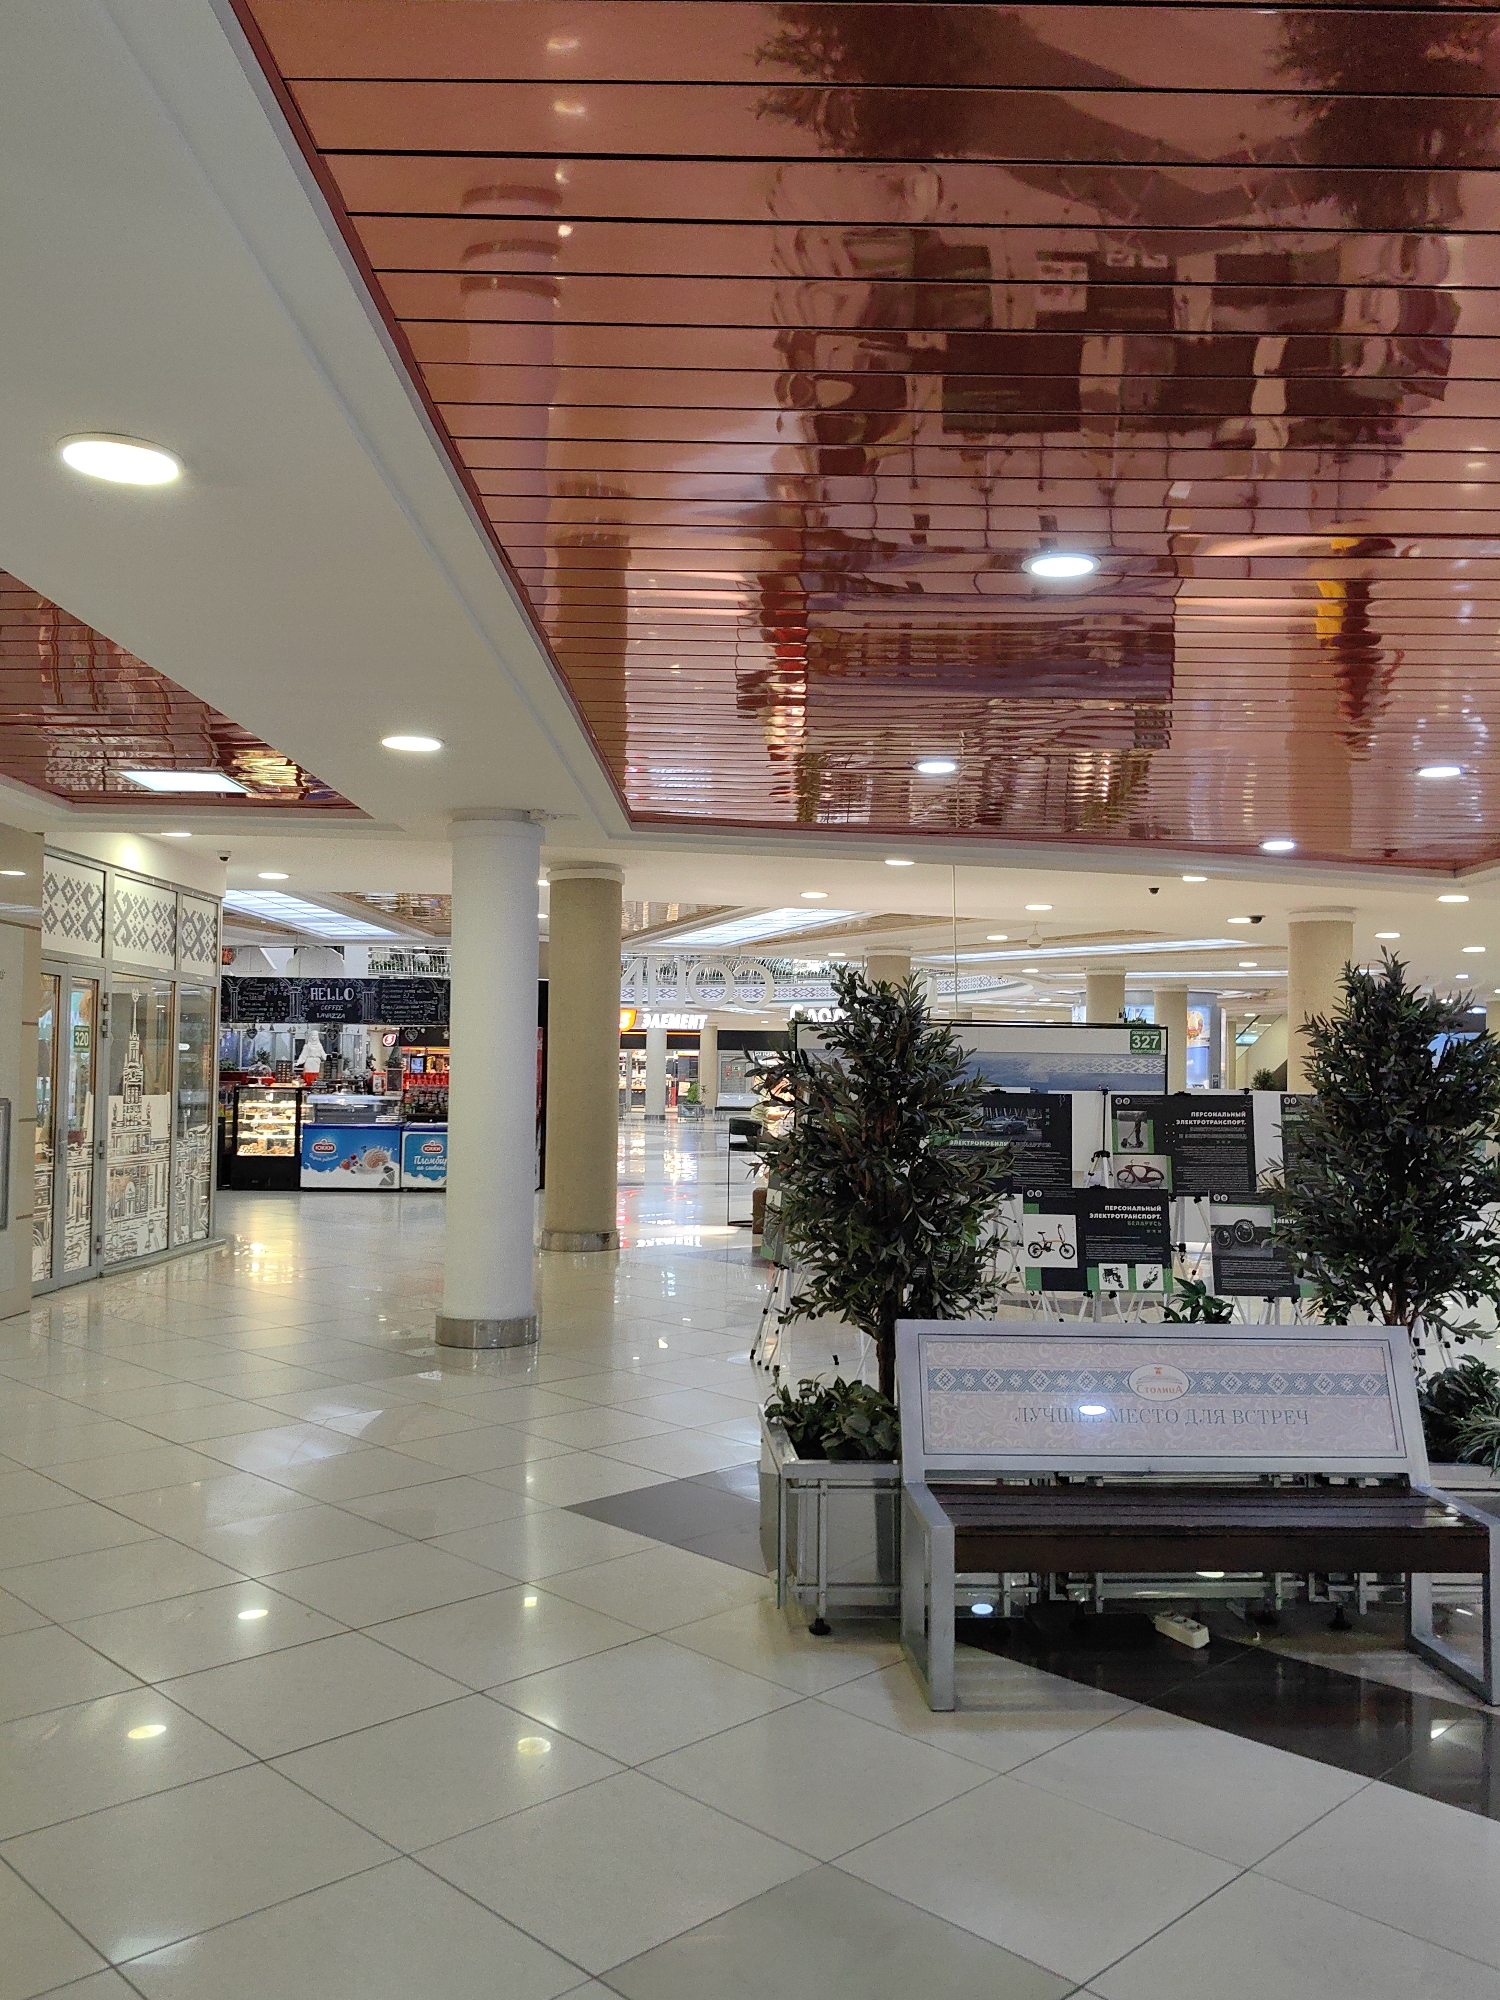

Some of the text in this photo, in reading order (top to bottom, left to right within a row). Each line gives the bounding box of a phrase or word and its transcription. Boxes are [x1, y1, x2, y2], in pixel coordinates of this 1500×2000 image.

[310, 987, 355, 1001] HELLO
[641, 1013, 708, 1030] ЭЛЕМЕНТ
[74, 1031, 89, 1046] 320
[1131, 1035, 1160, 1048] 327
[949, 1140, 1009, 1148] ЭЛЕКТРОМОБИЛИ
[1109, 1408, 1179, 1424] МЕСТО
[1185, 1409, 1226, 1426] ДЛЯ
[1233, 1409, 1309, 1425] ВСТРЕЧ
